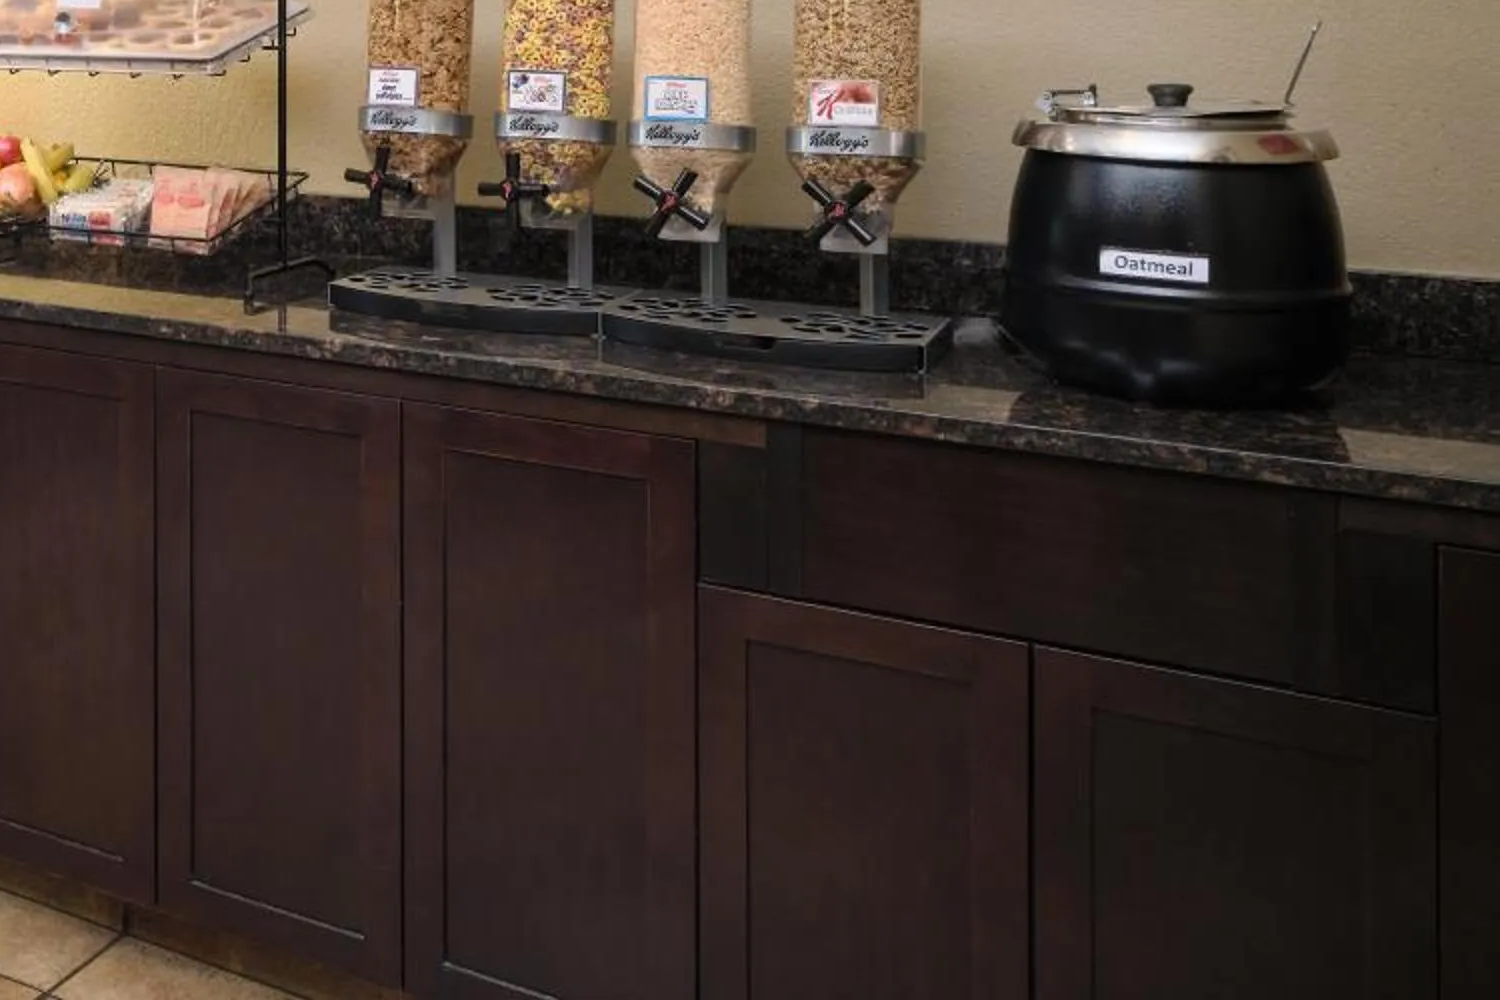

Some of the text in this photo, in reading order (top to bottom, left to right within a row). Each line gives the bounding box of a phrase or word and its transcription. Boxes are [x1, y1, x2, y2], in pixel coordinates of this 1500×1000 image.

[371, 110, 417, 129] Kellogg's
[509, 115, 560, 136] Kellogg's
[645, 123, 701, 145] Kellogg's
[809, 130, 869, 152] Kellogg's
[1113, 255, 1193, 277] Oatmeal
